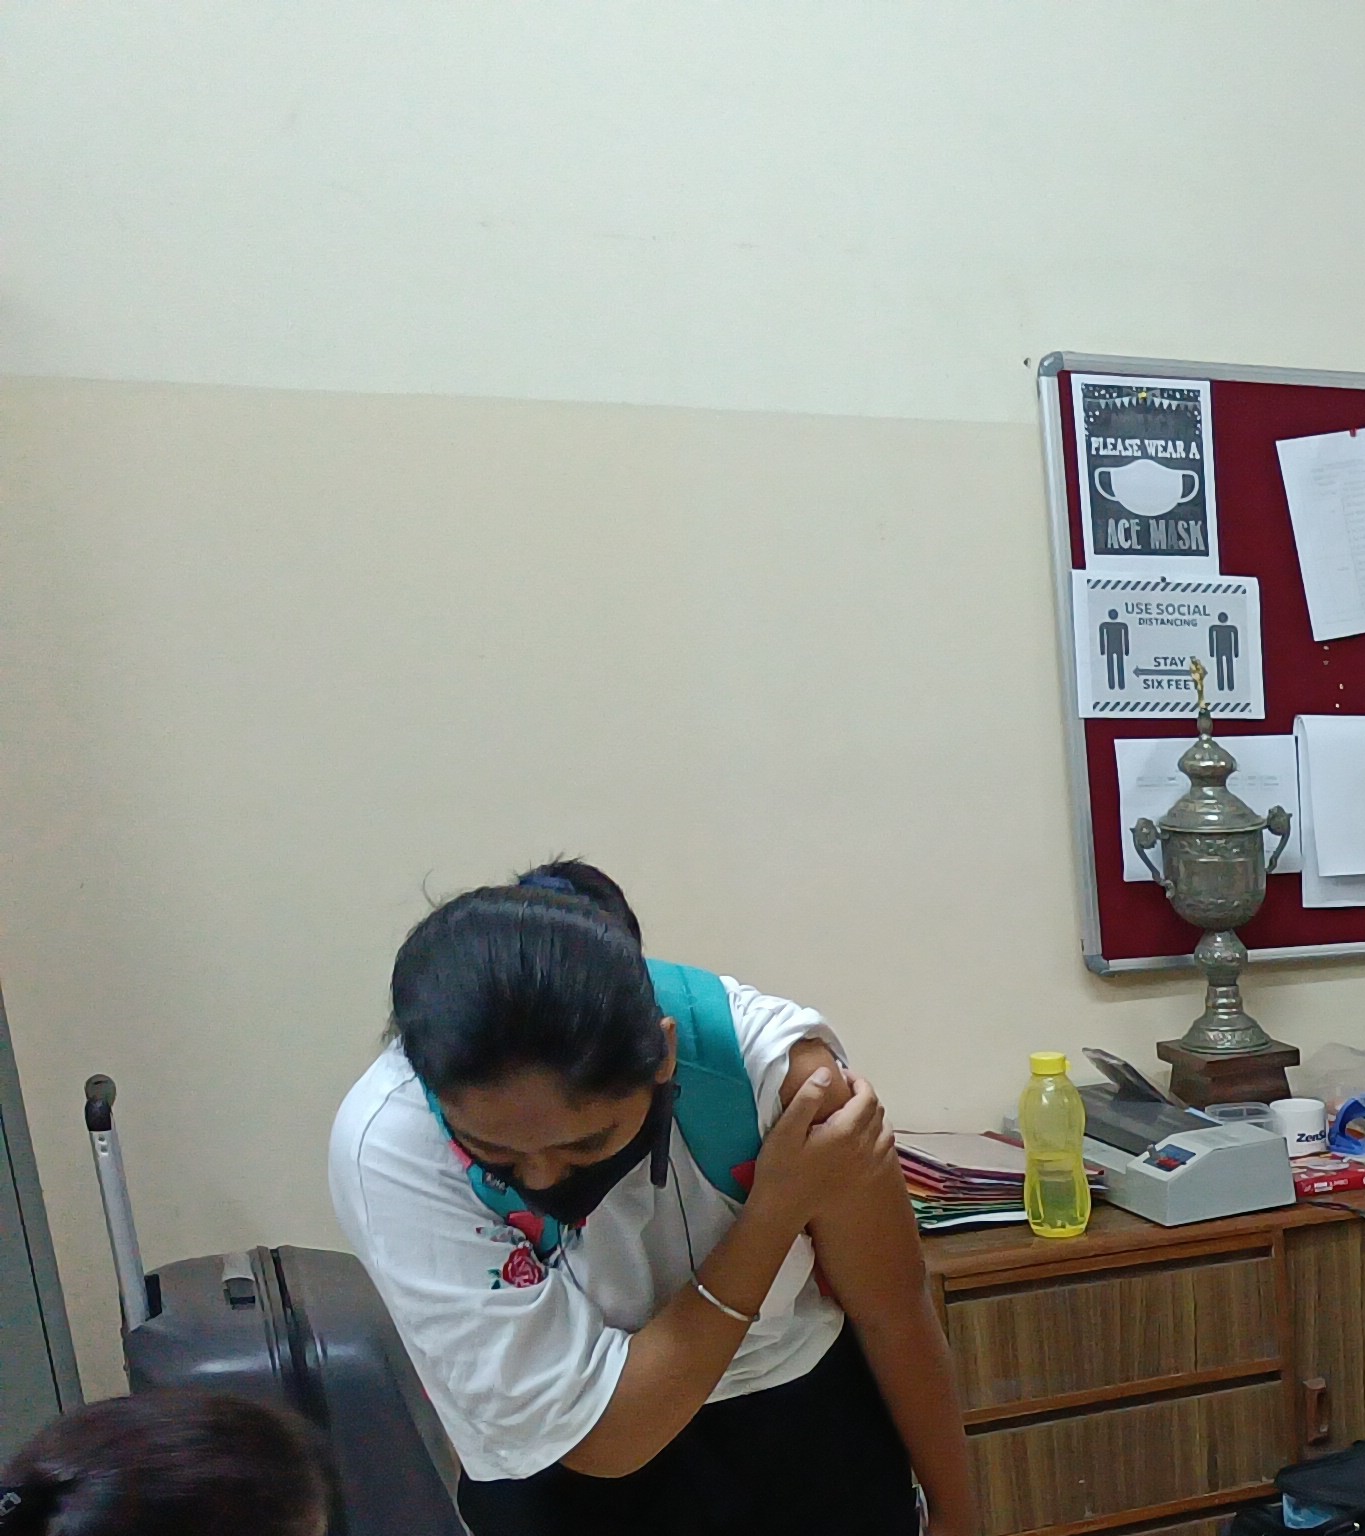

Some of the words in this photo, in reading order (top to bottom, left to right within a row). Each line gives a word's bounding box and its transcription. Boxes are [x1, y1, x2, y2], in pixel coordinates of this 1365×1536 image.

[1090, 437, 1141, 457] PLEASE
[1144, 439, 1186, 458] WEAR
[1189, 441, 1200, 459] A
[1149, 518, 1206, 551] MASK
[1124, 602, 1152, 615] USE
[1156, 603, 1211, 616] SOCIAL
[1138, 618, 1198, 627] DISTANCING
[1153, 656, 1186, 667] STAY
[1142, 678, 1164, 690] SIX
